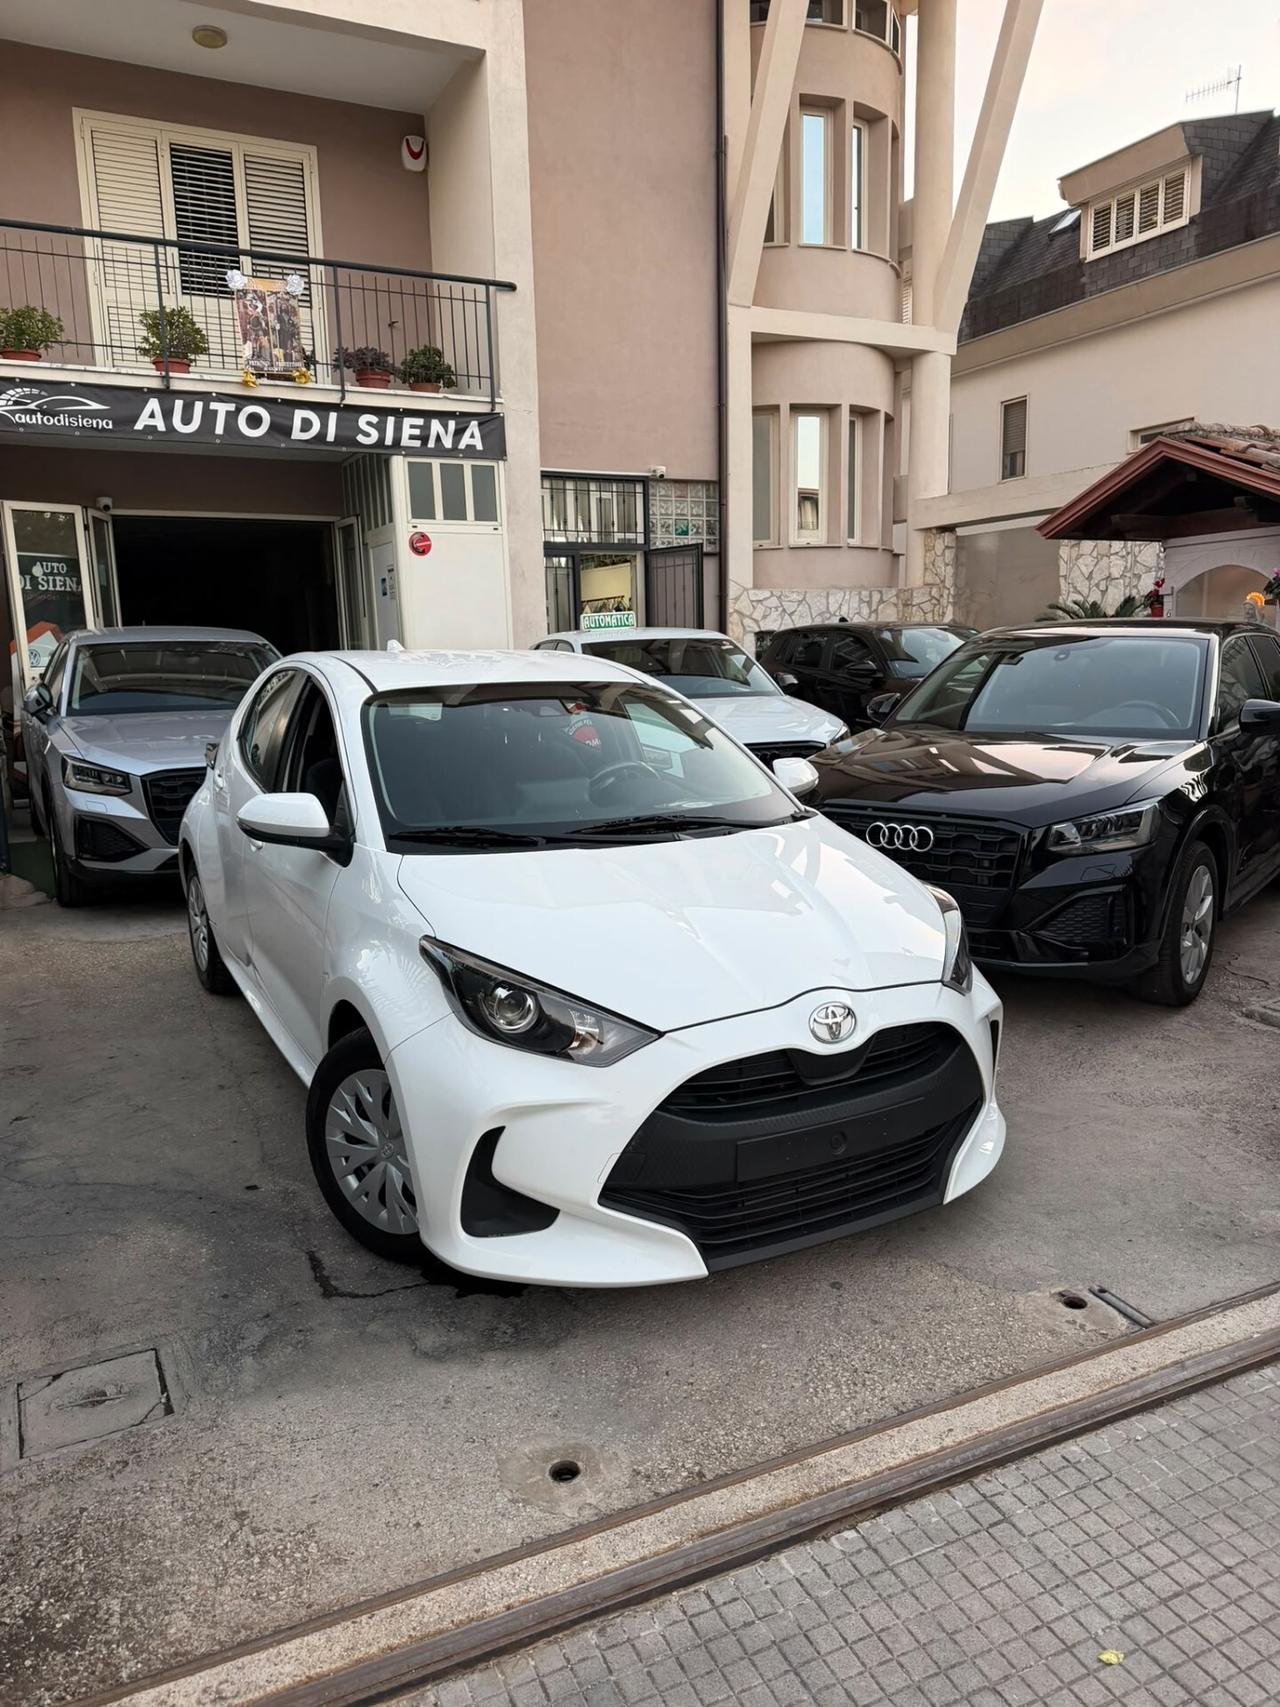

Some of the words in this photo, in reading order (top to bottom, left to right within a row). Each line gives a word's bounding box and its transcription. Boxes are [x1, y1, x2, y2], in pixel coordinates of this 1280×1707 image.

[14, 411, 113, 430] autodisiena
[133, 397, 271, 438] AUTO
[290, 408, 338, 442] DI
[355, 413, 484, 450] SIENA
[38, 575, 81, 591] SIEN
[584, 614, 633, 628] AUTOMATICA
